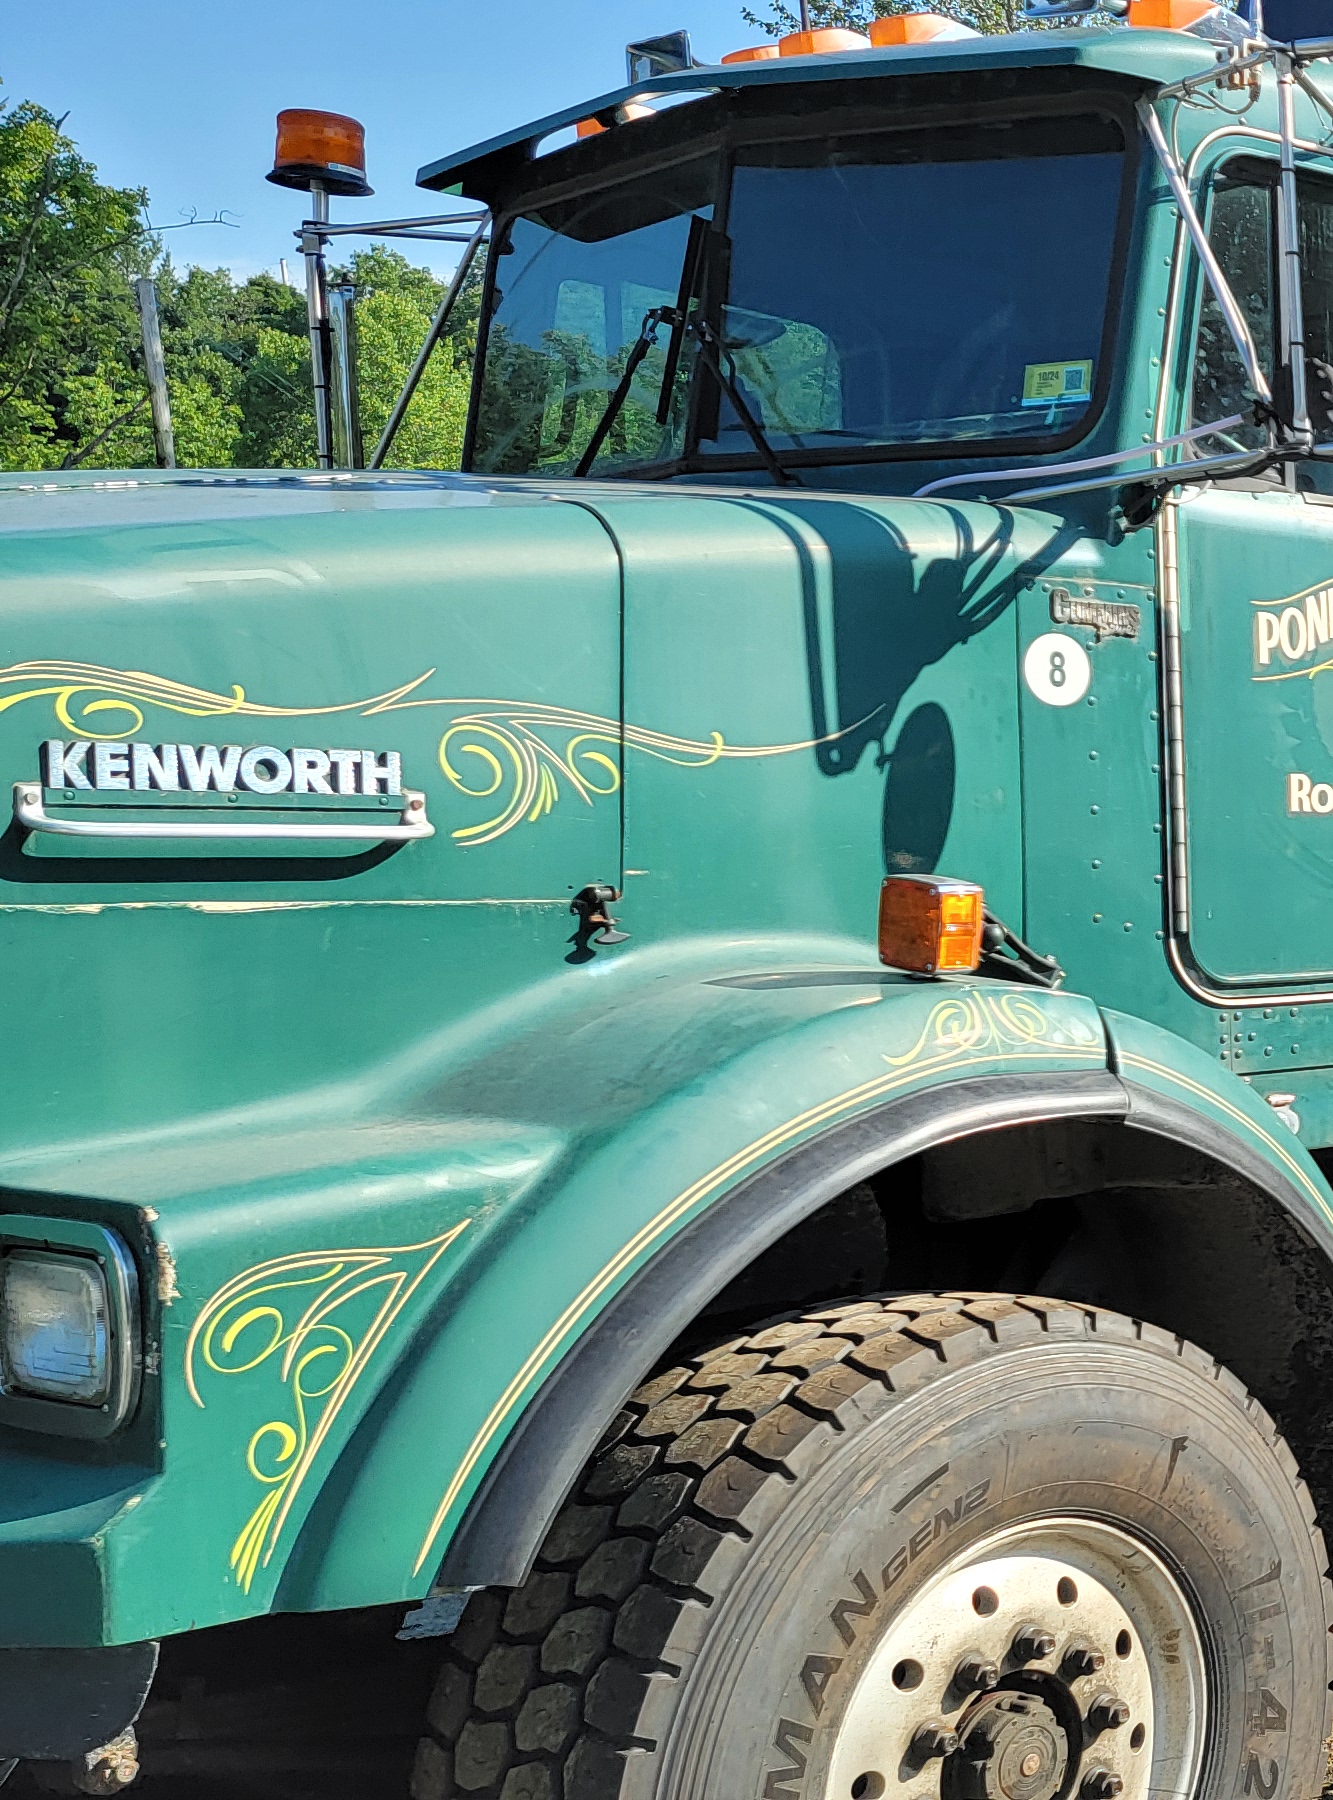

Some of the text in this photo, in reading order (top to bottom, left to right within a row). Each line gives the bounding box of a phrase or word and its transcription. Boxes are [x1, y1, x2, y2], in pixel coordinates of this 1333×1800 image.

[1037, 371, 1060, 382] 10/24
[1049, 651, 1066, 687] 8
[42, 740, 402, 796] KENWORTH
[881, 1478, 991, 1592] GEN2
